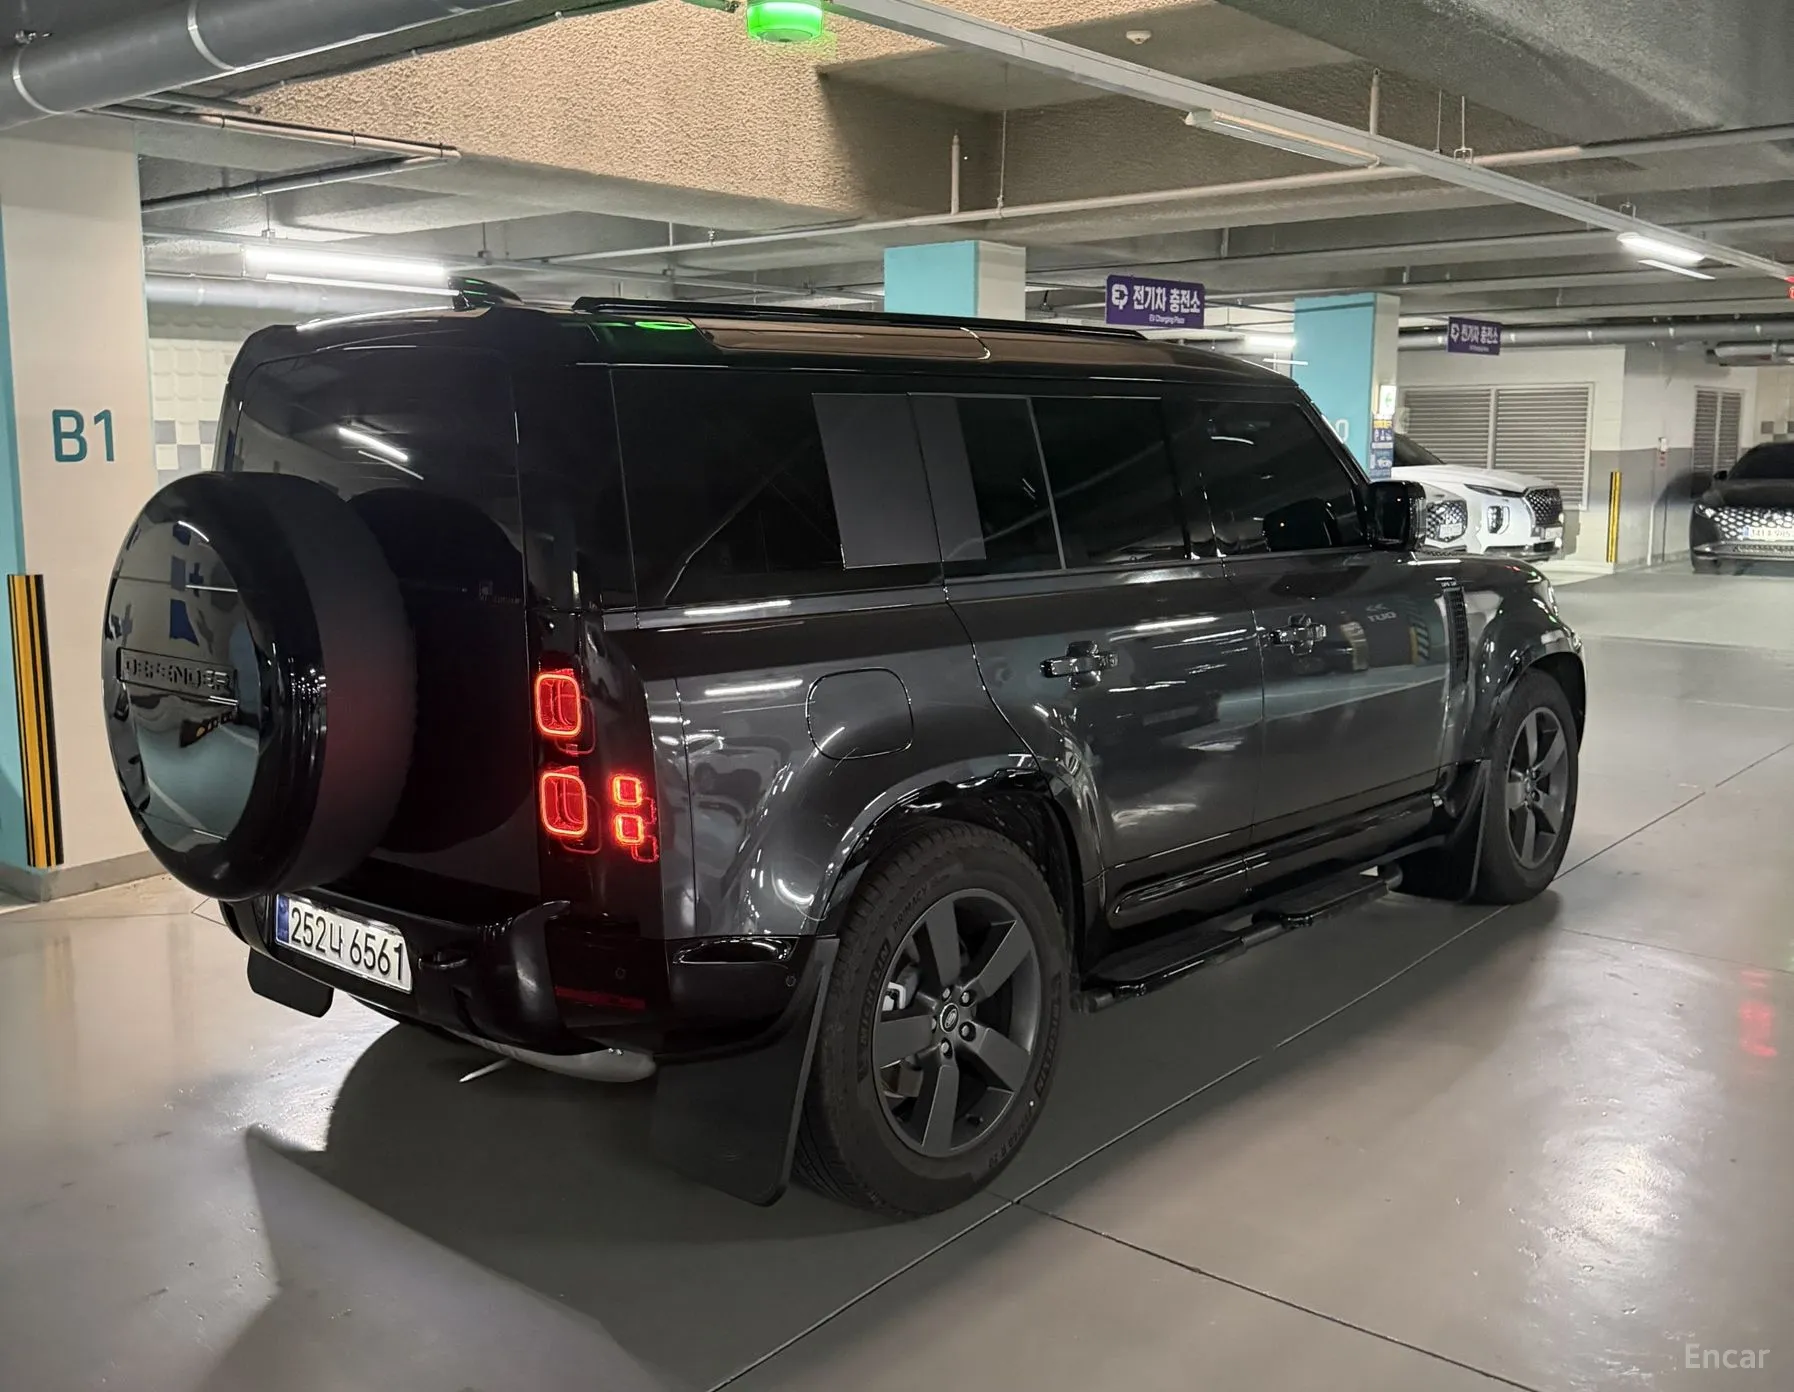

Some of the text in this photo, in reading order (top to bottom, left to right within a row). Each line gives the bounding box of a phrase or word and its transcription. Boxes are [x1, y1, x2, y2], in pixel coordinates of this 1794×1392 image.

[1132, 285, 1201, 314] 전기차 충전소
[52, 408, 115, 462] B1
[125, 658, 231, 692] DEFENDER
[291, 906, 404, 981] 252나 6561
[859, 942, 891, 1048] MICHELIN
